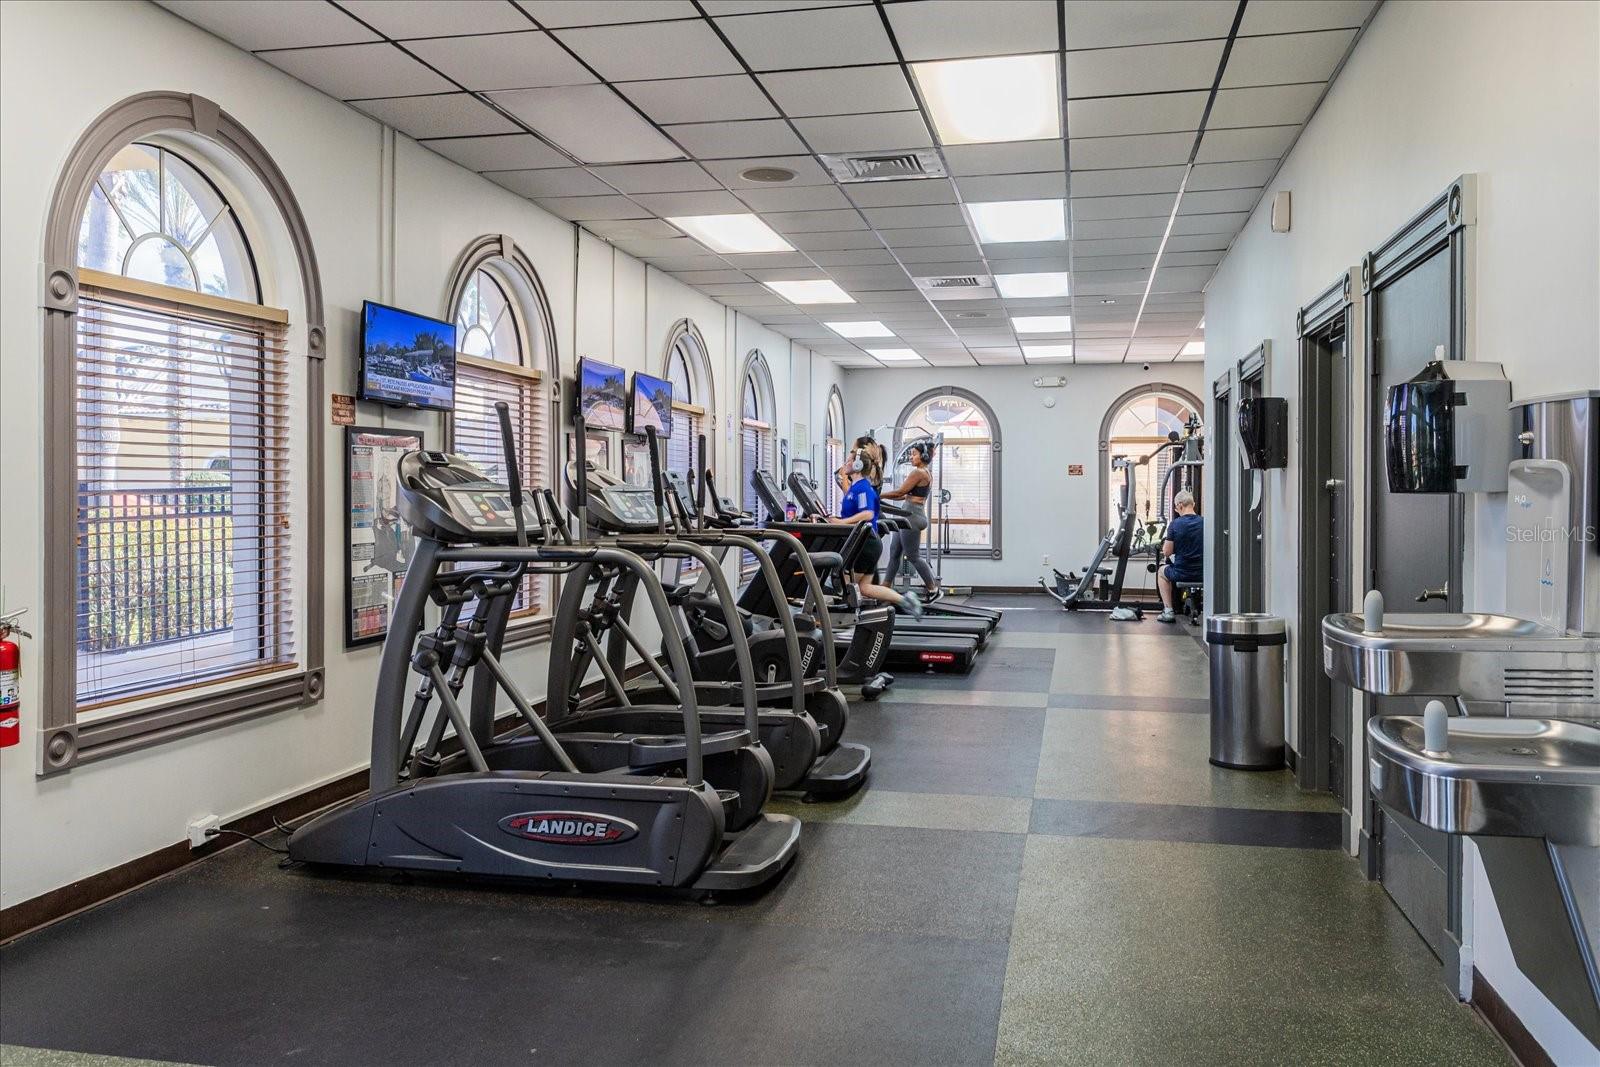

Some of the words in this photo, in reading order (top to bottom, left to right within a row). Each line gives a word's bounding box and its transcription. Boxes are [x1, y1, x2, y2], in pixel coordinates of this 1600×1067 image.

[800, 643, 815, 675] NDICE
[866, 632, 884, 668] LANDICE
[527, 819, 608, 837] LANDICE
